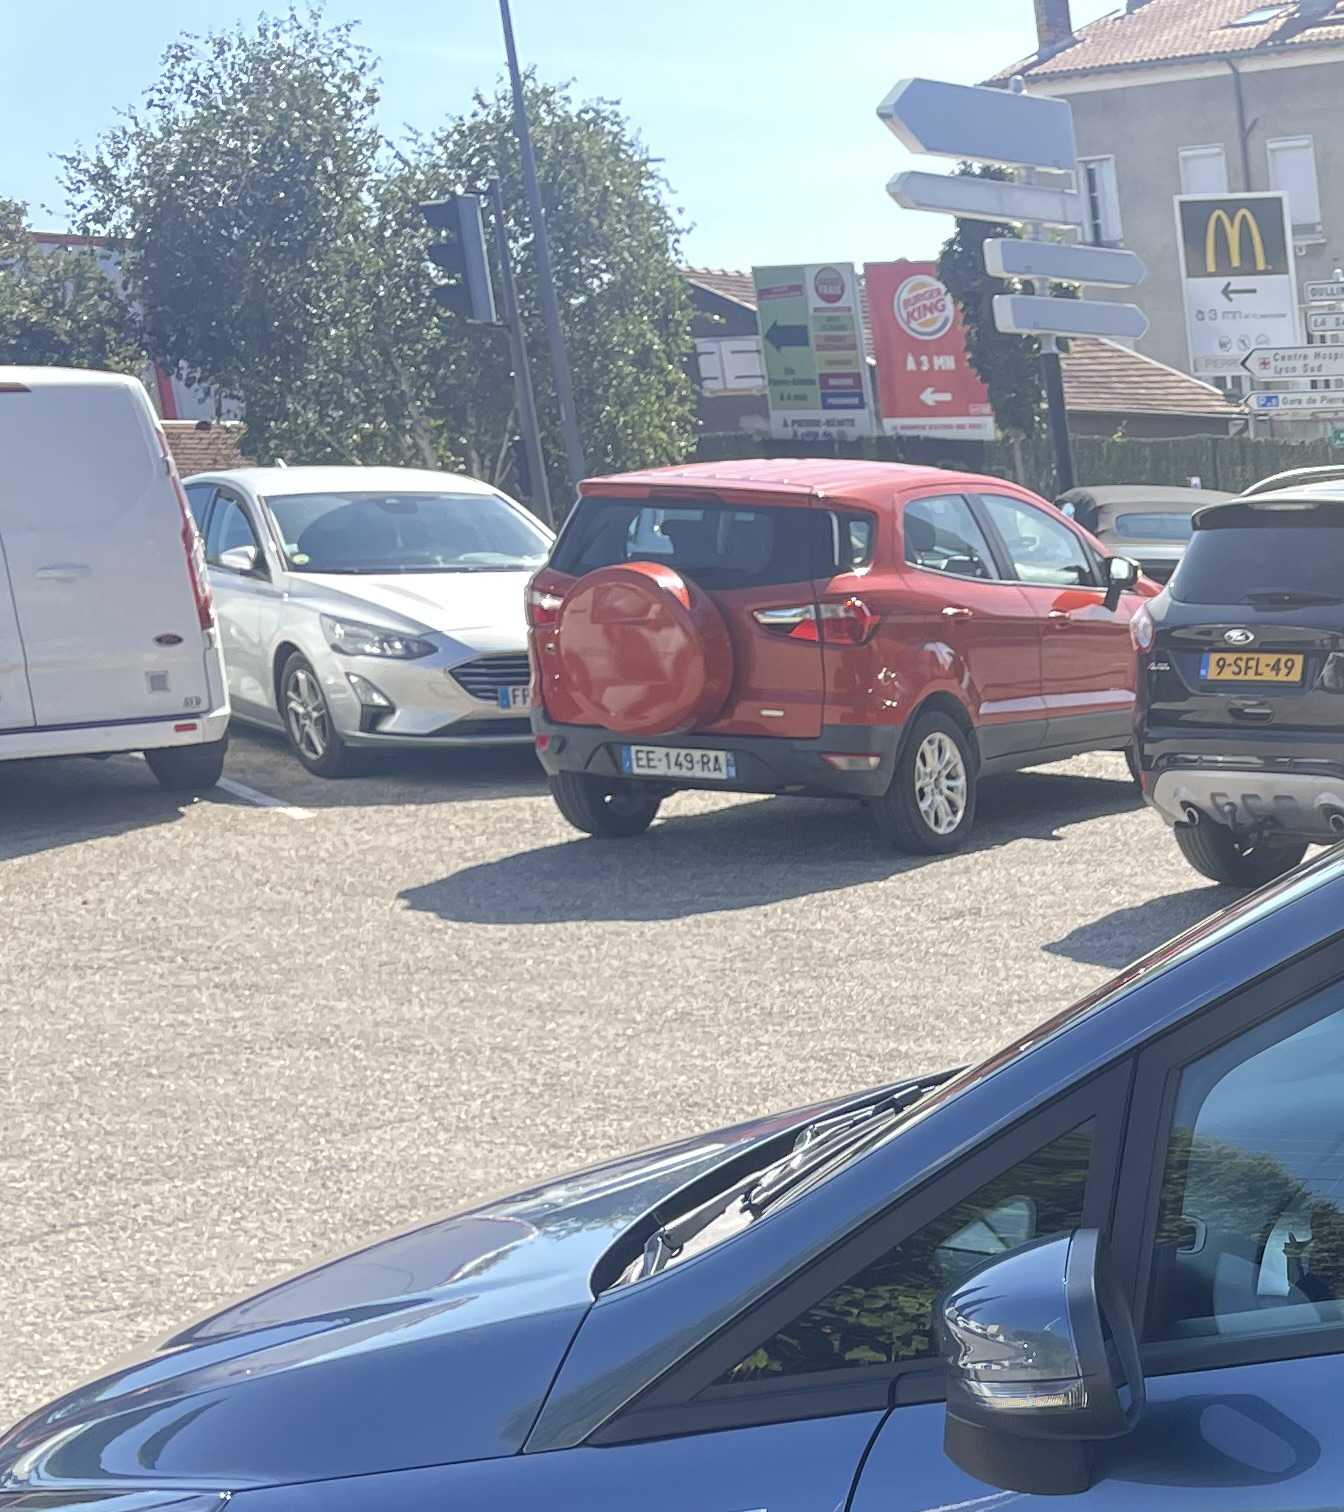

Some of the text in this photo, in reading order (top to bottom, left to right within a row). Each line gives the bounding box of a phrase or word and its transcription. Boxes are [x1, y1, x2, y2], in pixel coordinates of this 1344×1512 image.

[902, 287, 941, 309] BURGER
[906, 298, 946, 323] KING
[1208, 309, 1218, 321] 3
[1314, 318, 1326, 327] LA
[920, 354, 930, 372] 3
[1273, 352, 1308, 362] Centre
[1274, 363, 1323, 375] Lyon Sud
[1281, 397, 1302, 406] Gare
[1306, 396, 1317, 405] de
[1216, 657, 1295, 677] 9-SFL-49
[635, 749, 722, 773] EE-149-RA
